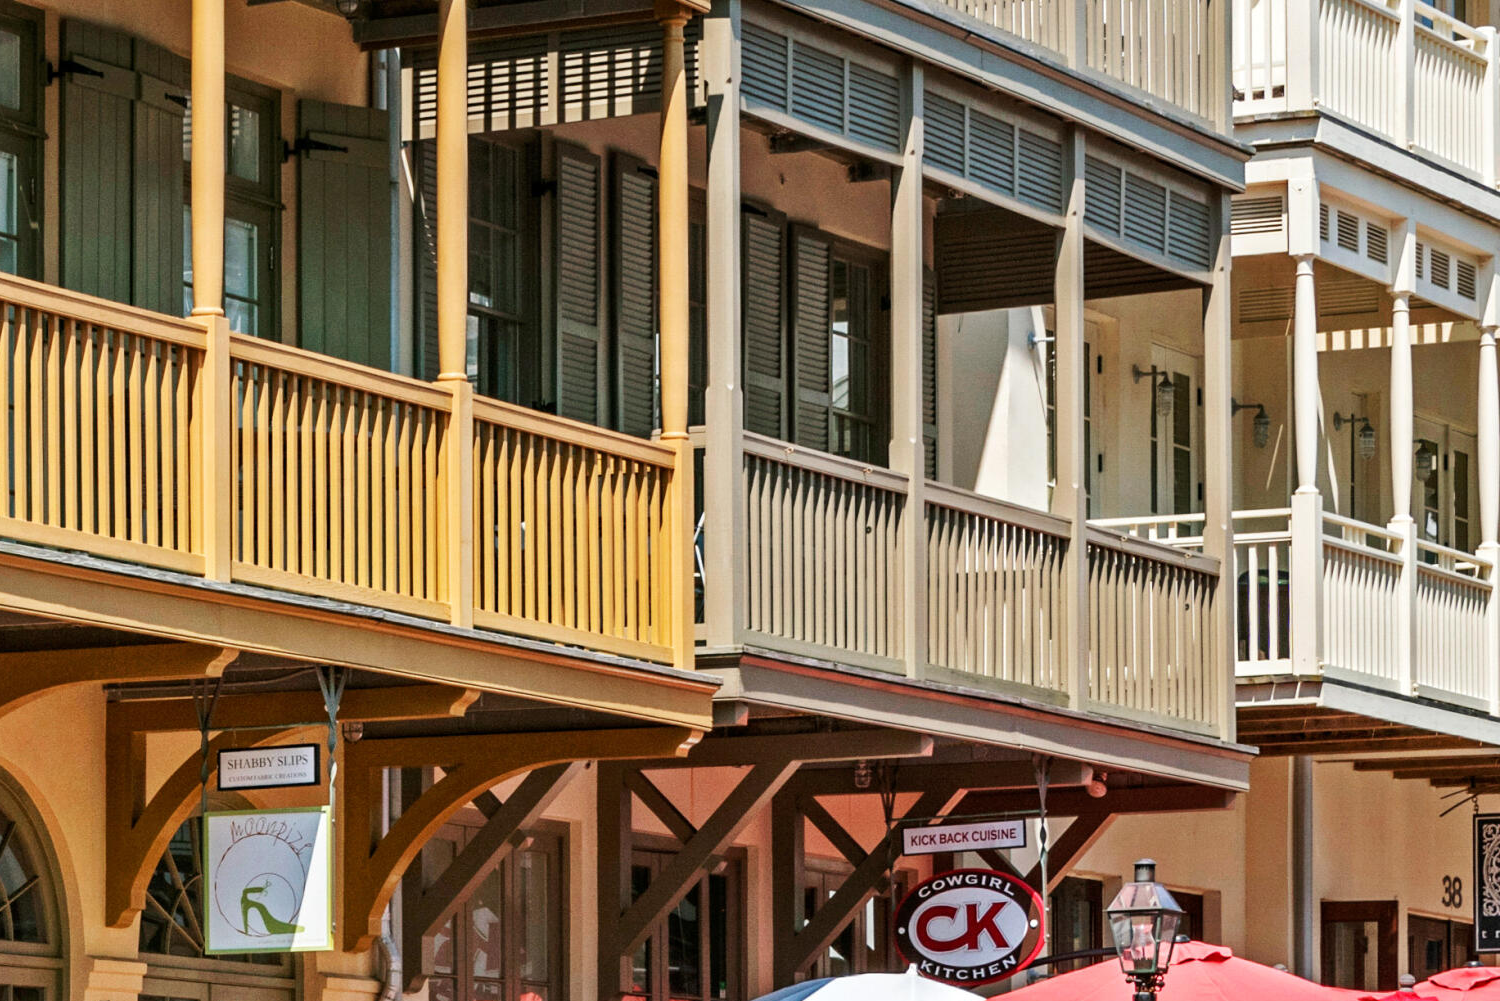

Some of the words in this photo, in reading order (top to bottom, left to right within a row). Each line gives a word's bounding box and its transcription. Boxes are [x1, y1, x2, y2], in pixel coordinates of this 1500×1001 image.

[227, 756, 275, 770] SHABBY
[277, 754, 309, 767] SLIPS
[910, 833, 937, 847] KICK
[939, 831, 969, 845] BACK
[972, 828, 1017, 842] CUISINE
[917, 874, 1015, 899] COWGIRL
[1442, 875, 1462, 908] 38
[916, 901, 1010, 952] CK
[920, 954, 1018, 980] KITCHEN
